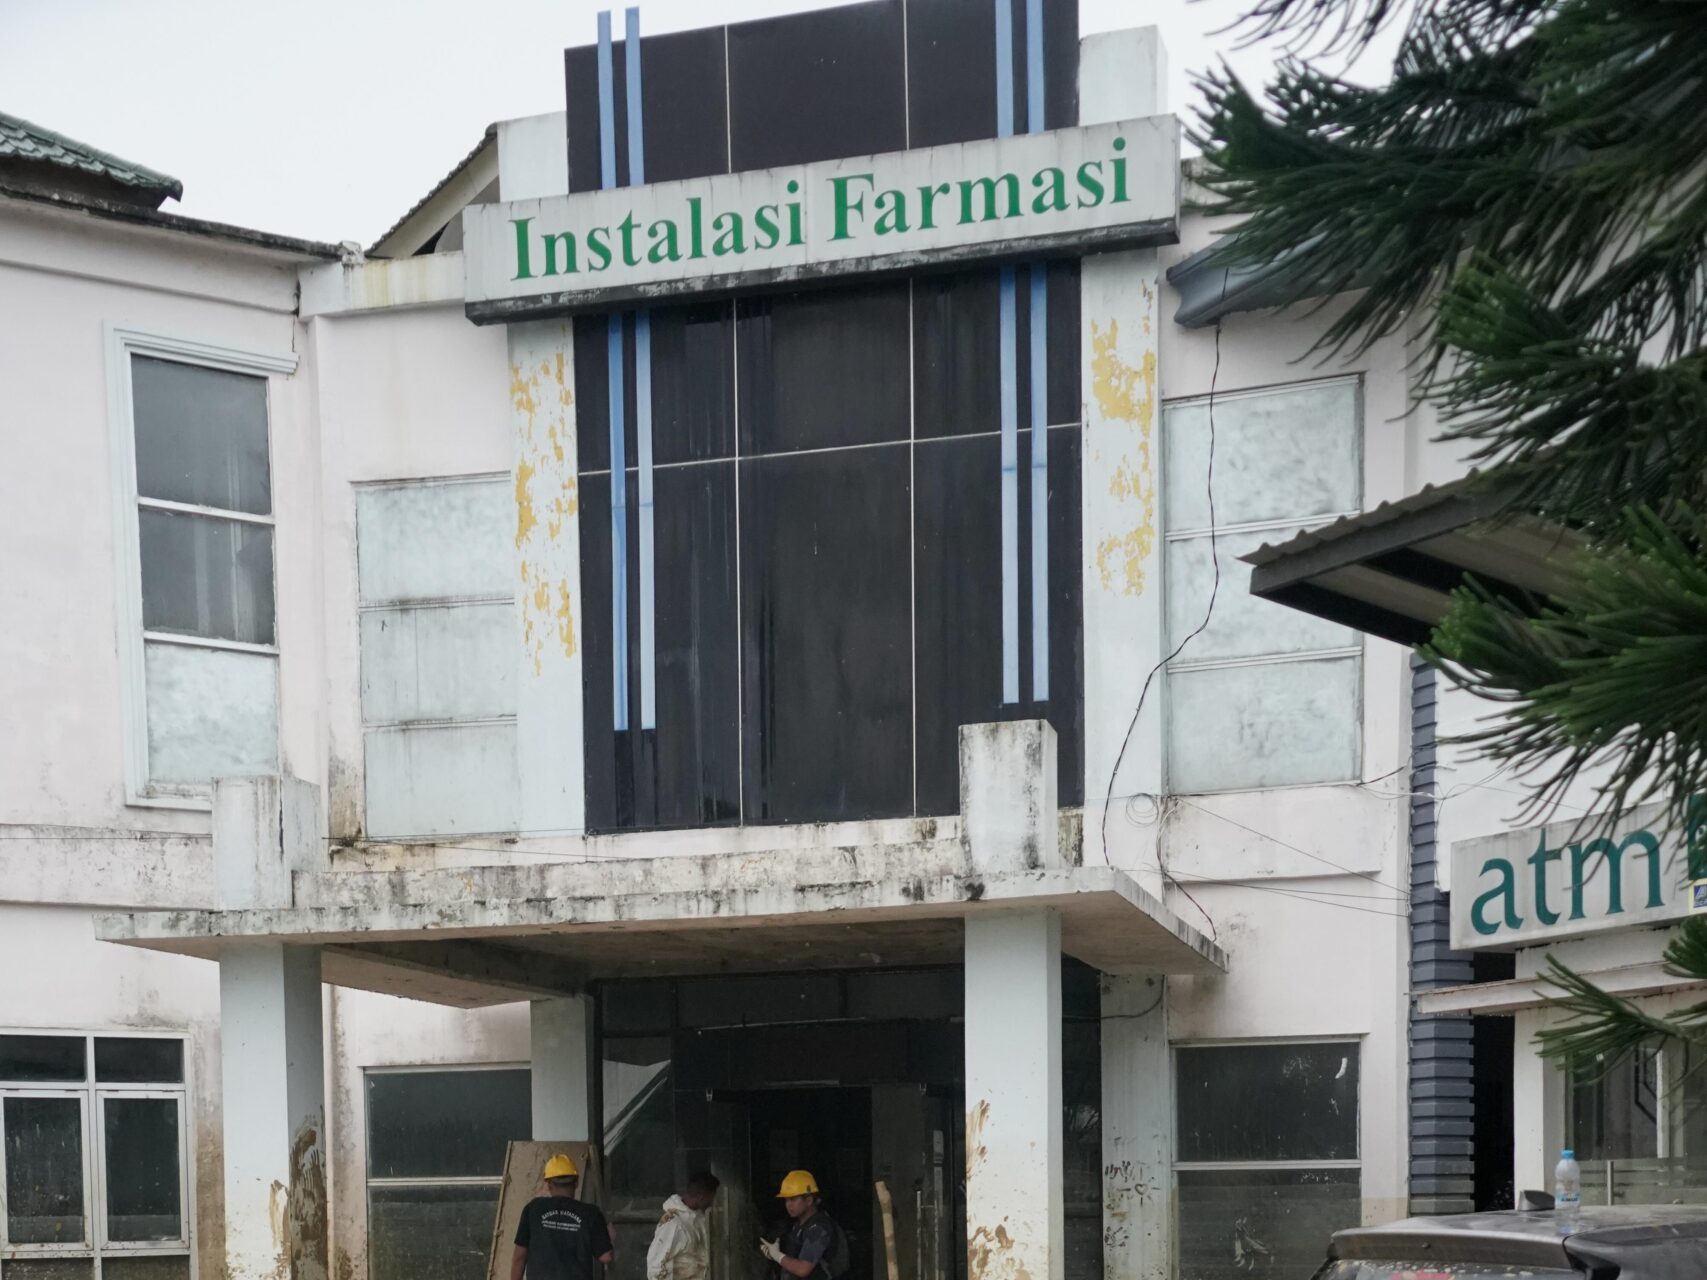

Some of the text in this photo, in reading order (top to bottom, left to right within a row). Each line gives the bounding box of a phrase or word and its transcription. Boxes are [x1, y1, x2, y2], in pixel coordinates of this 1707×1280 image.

[509, 137, 1133, 282] Instalasi Farmasi
[1471, 827, 1666, 935] atm
